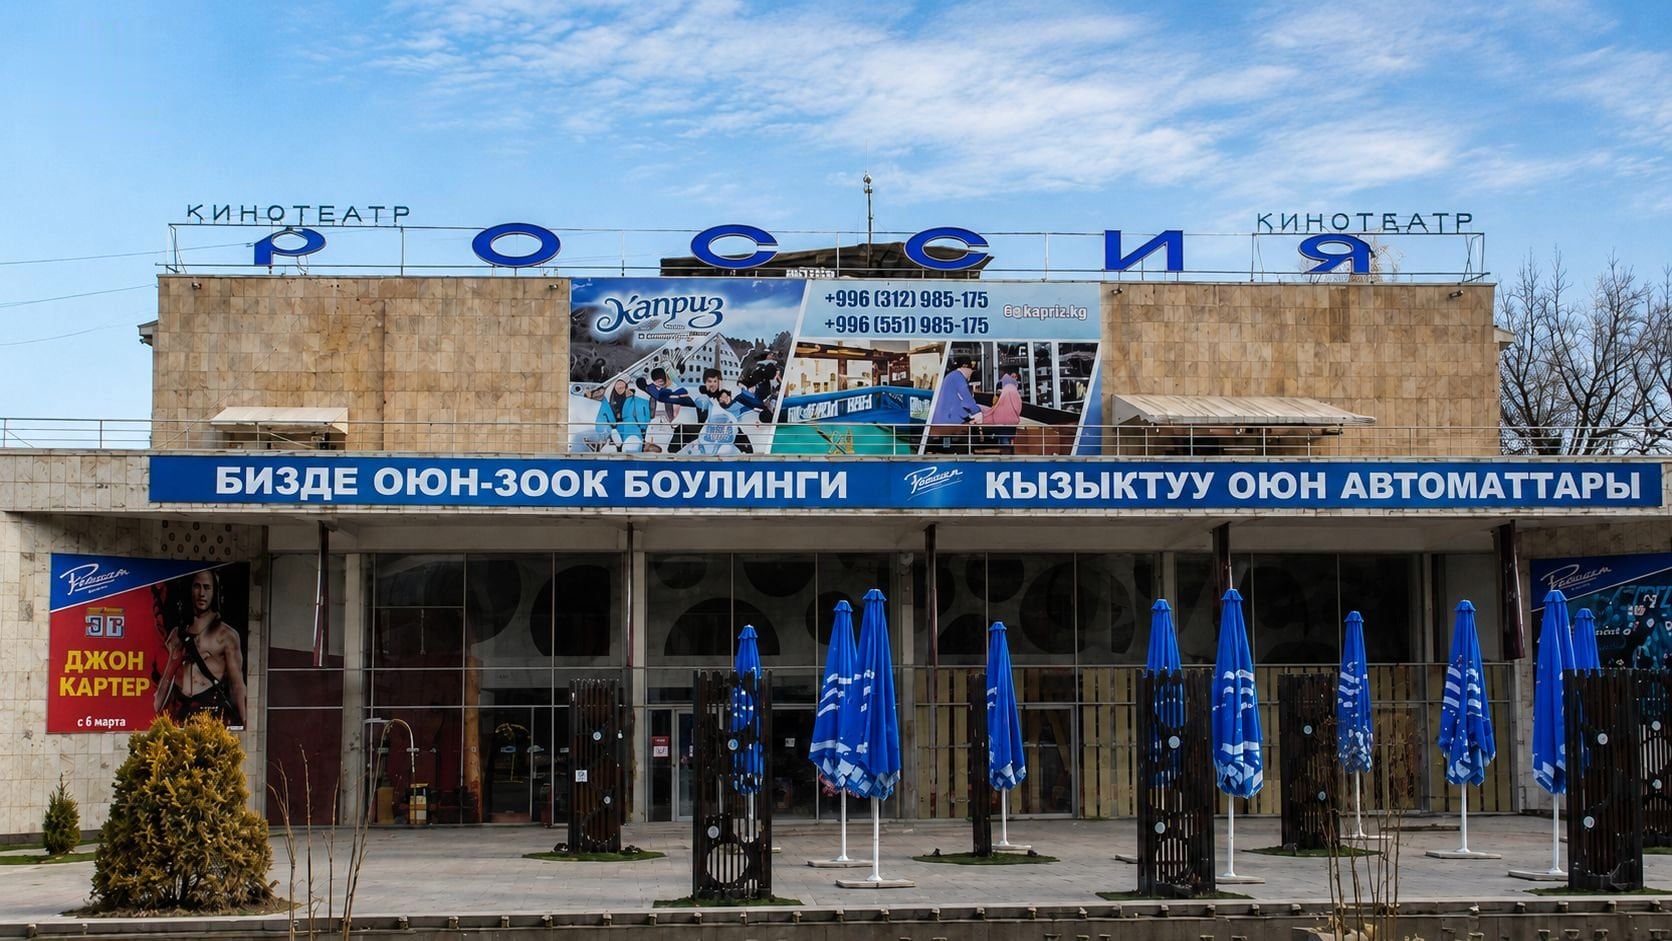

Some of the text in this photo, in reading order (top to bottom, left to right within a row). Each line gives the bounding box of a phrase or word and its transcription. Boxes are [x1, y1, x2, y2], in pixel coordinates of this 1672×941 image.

[187, 205, 410, 224] КИНОТЕАТР
[1257, 212, 1473, 233] КИНОТЕАТР
[253, 222, 1371, 274] РОССИЯ
[825, 289, 989, 309] +996 (312) 985-175
[595, 294, 724, 333] Каприз
[825, 315, 989, 335] +996 (551) 985-175
[215, 466, 848, 501] БИЗДЕ ОЮН-ЗООК БОУЛИНГИ
[985, 471, 1215, 499] КЫЗЫКТУУ
[1228, 471, 1327, 499] ОЮН
[1340, 471, 1640, 500] АВТОМАТТАРЫ
[64, 650, 145, 674] ДЖОН
[59, 676, 150, 697] КАРТЕР
[77, 716, 126, 729] с 6 марта
